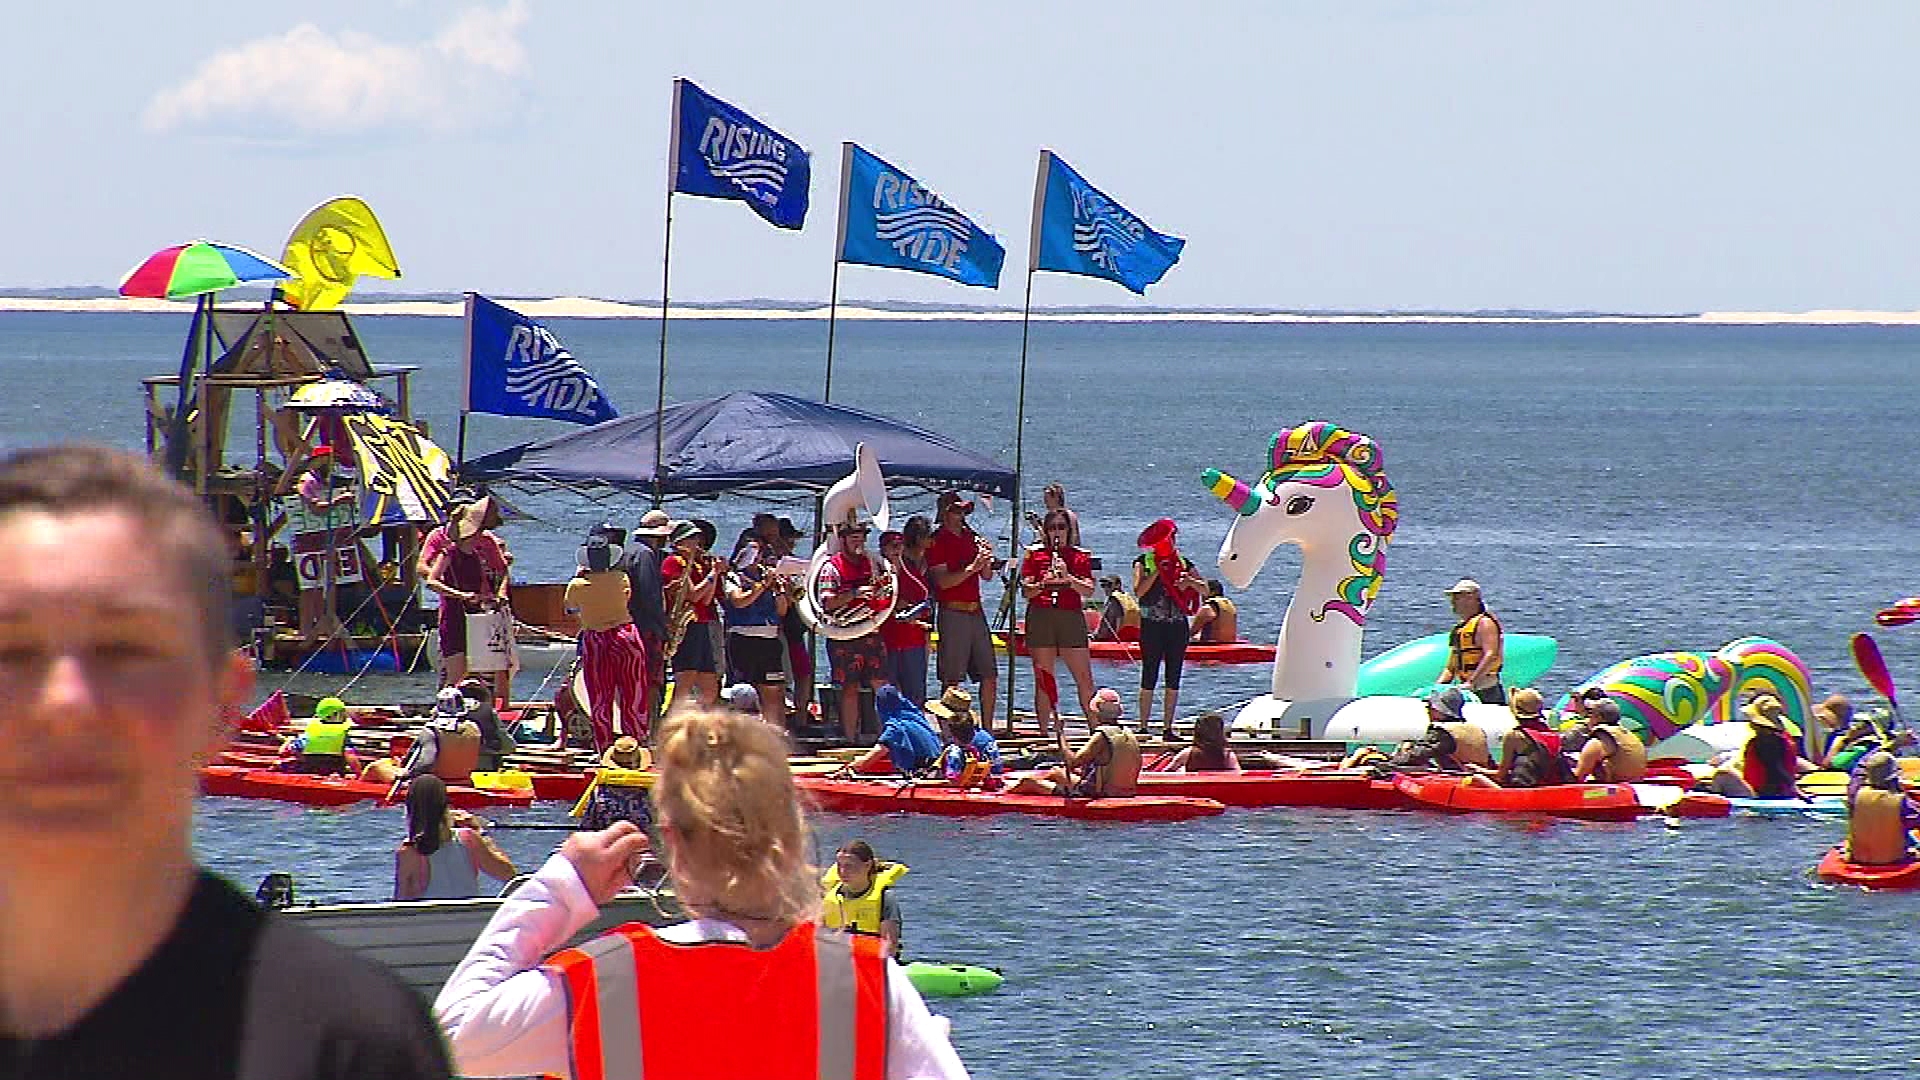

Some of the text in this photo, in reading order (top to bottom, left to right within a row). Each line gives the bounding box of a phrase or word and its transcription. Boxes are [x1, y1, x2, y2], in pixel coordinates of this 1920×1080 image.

[699, 117, 786, 162] RISING
[893, 231, 968, 274] TIDE
[521, 377, 599, 417] TIDE
